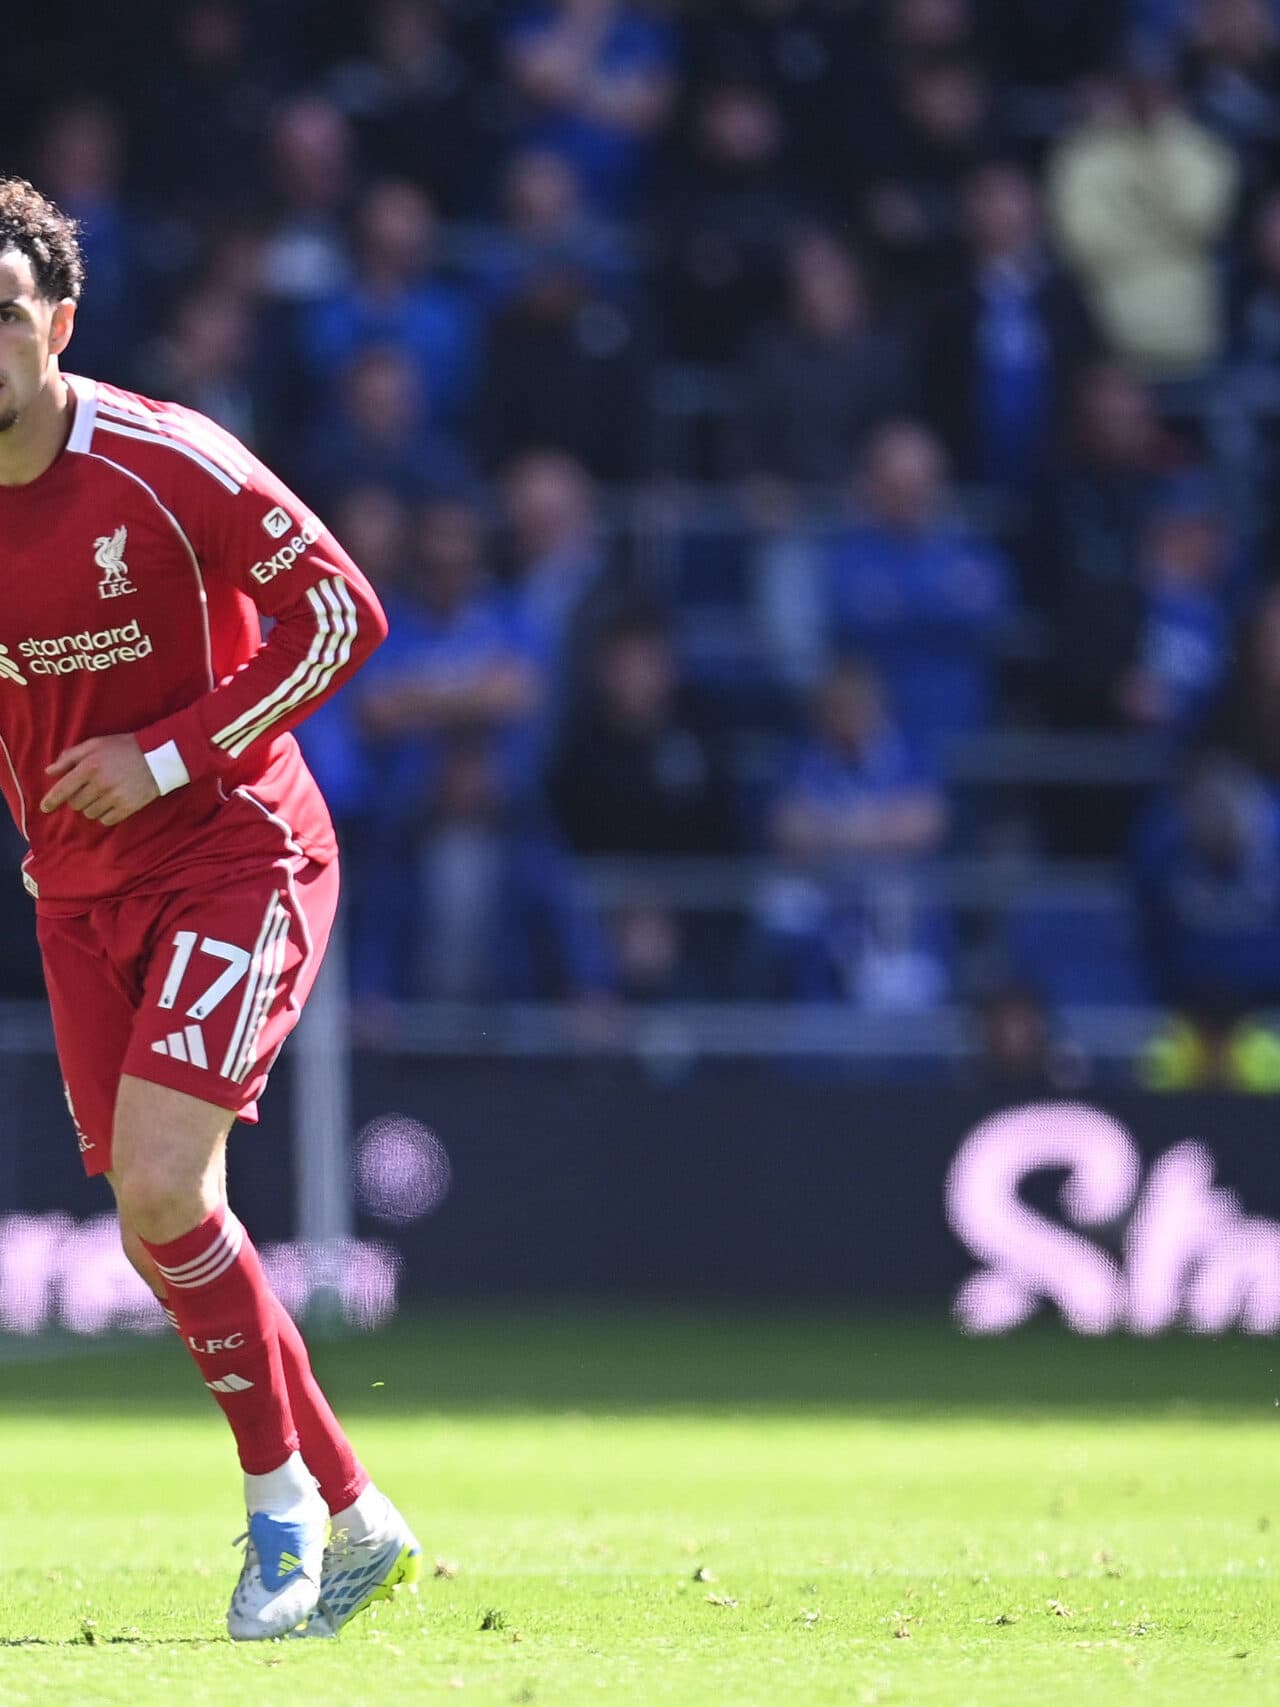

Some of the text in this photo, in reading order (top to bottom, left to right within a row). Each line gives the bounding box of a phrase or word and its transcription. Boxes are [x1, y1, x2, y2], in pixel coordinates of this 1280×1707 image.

[19, 619, 141, 656] standard
[29, 635, 153, 676] chartered
[157, 930, 251, 1021] 17
[188, 1332, 245, 1354] LFC
